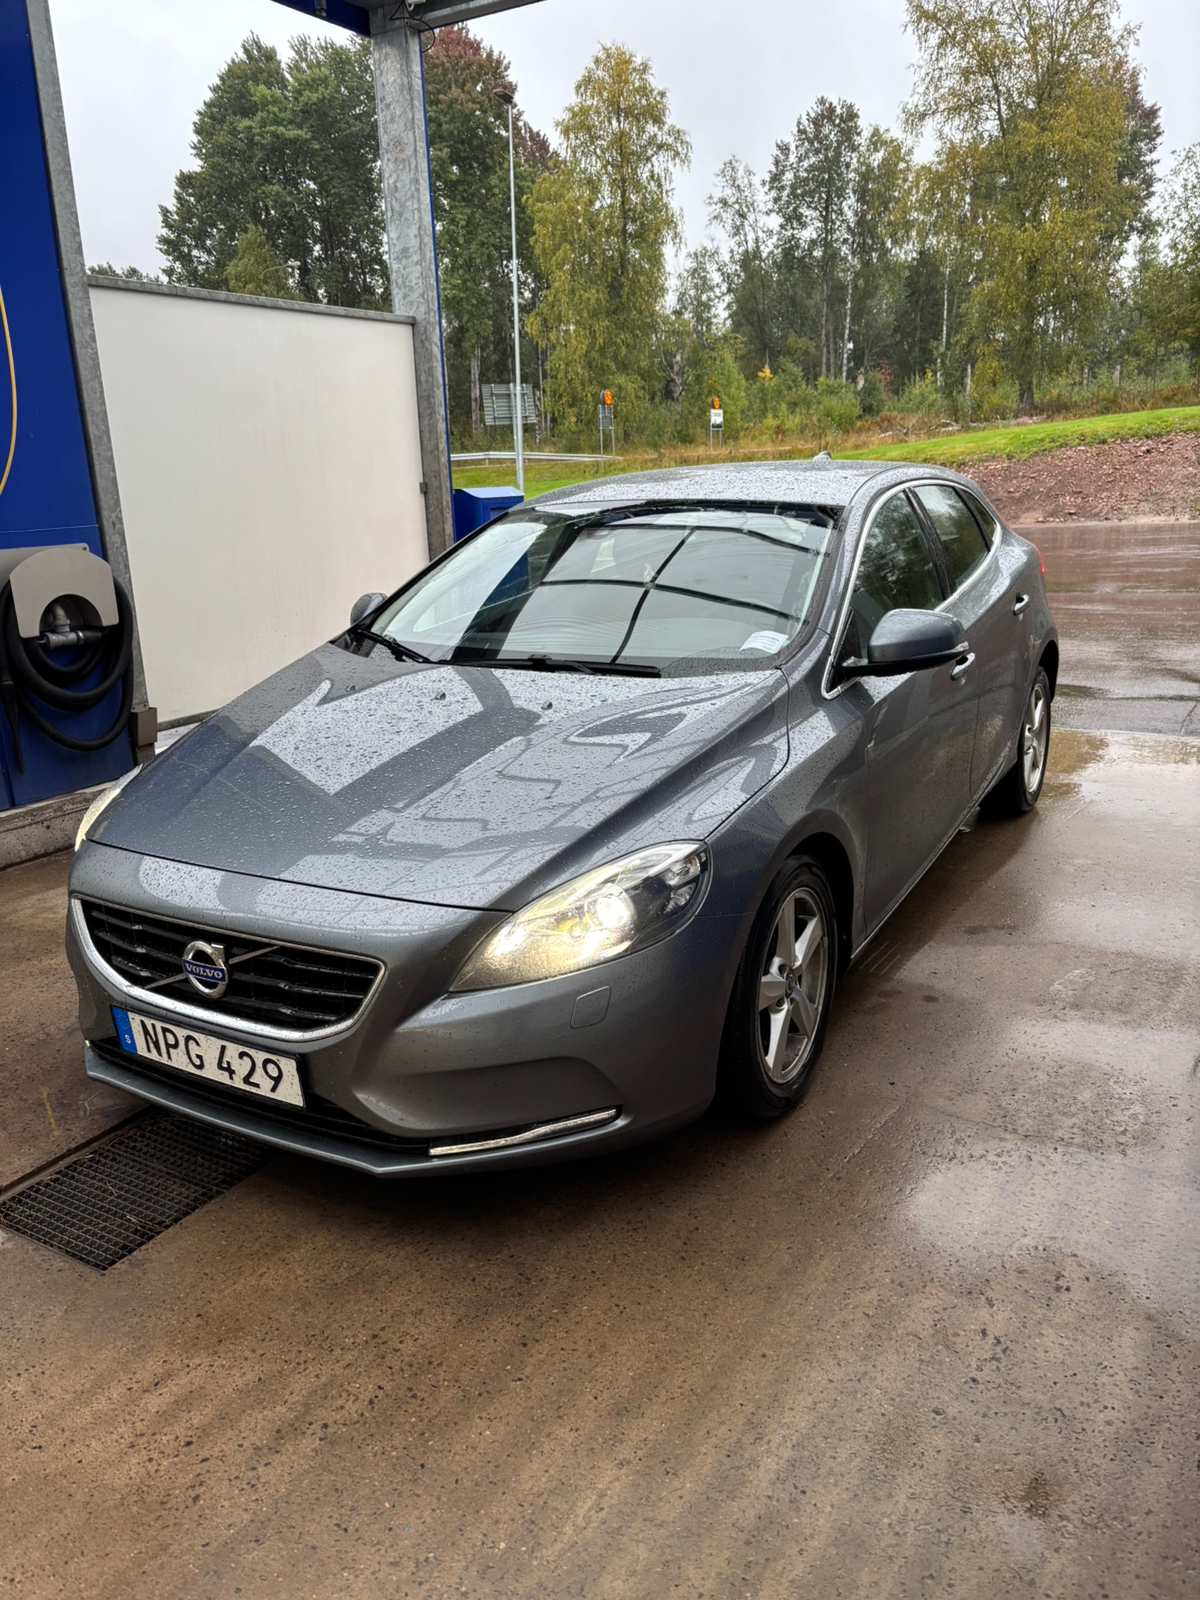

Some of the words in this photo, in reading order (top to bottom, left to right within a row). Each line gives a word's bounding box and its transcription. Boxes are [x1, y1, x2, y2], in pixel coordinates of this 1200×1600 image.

[185, 963, 223, 979] VOLVO
[124, 1034, 132, 1044] S
[140, 1019, 204, 1070] NPG
[217, 1044, 283, 1093] 429
